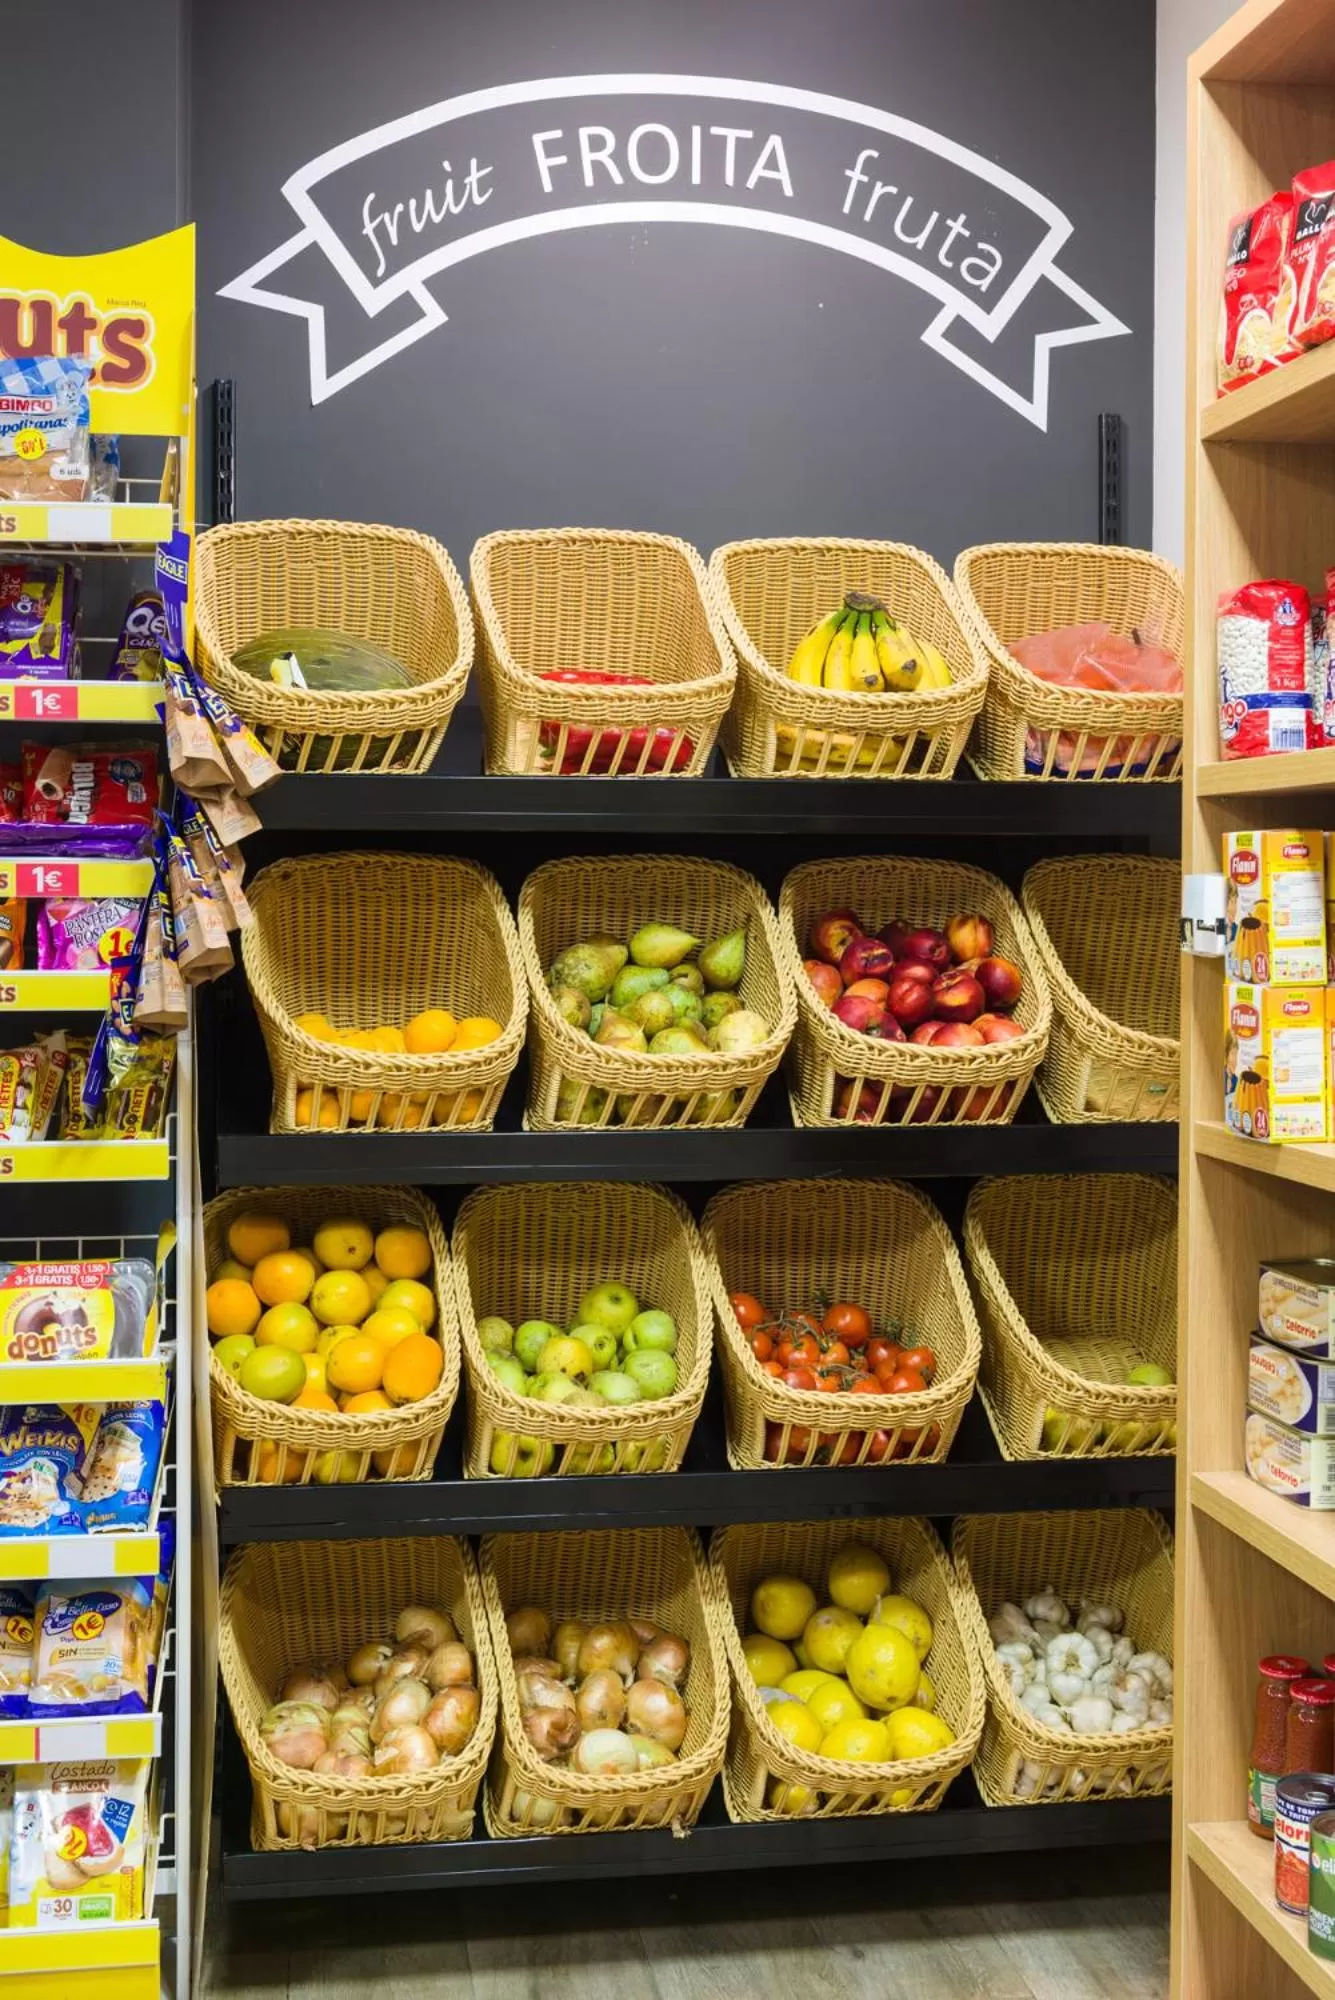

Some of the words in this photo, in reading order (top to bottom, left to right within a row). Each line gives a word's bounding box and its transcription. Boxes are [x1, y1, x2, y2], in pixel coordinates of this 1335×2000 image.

[362, 156, 494, 277] fruit
[532, 122, 794, 197] FROITA
[842, 148, 1003, 293] fruta
[158, 553, 186, 580] EAGLE
[64, 906, 122, 936] PANTERA
[34, 1275, 74, 1285] GRATIS
[58, 1648, 78, 1659] SIN
[54, 1898, 73, 1914] 30
